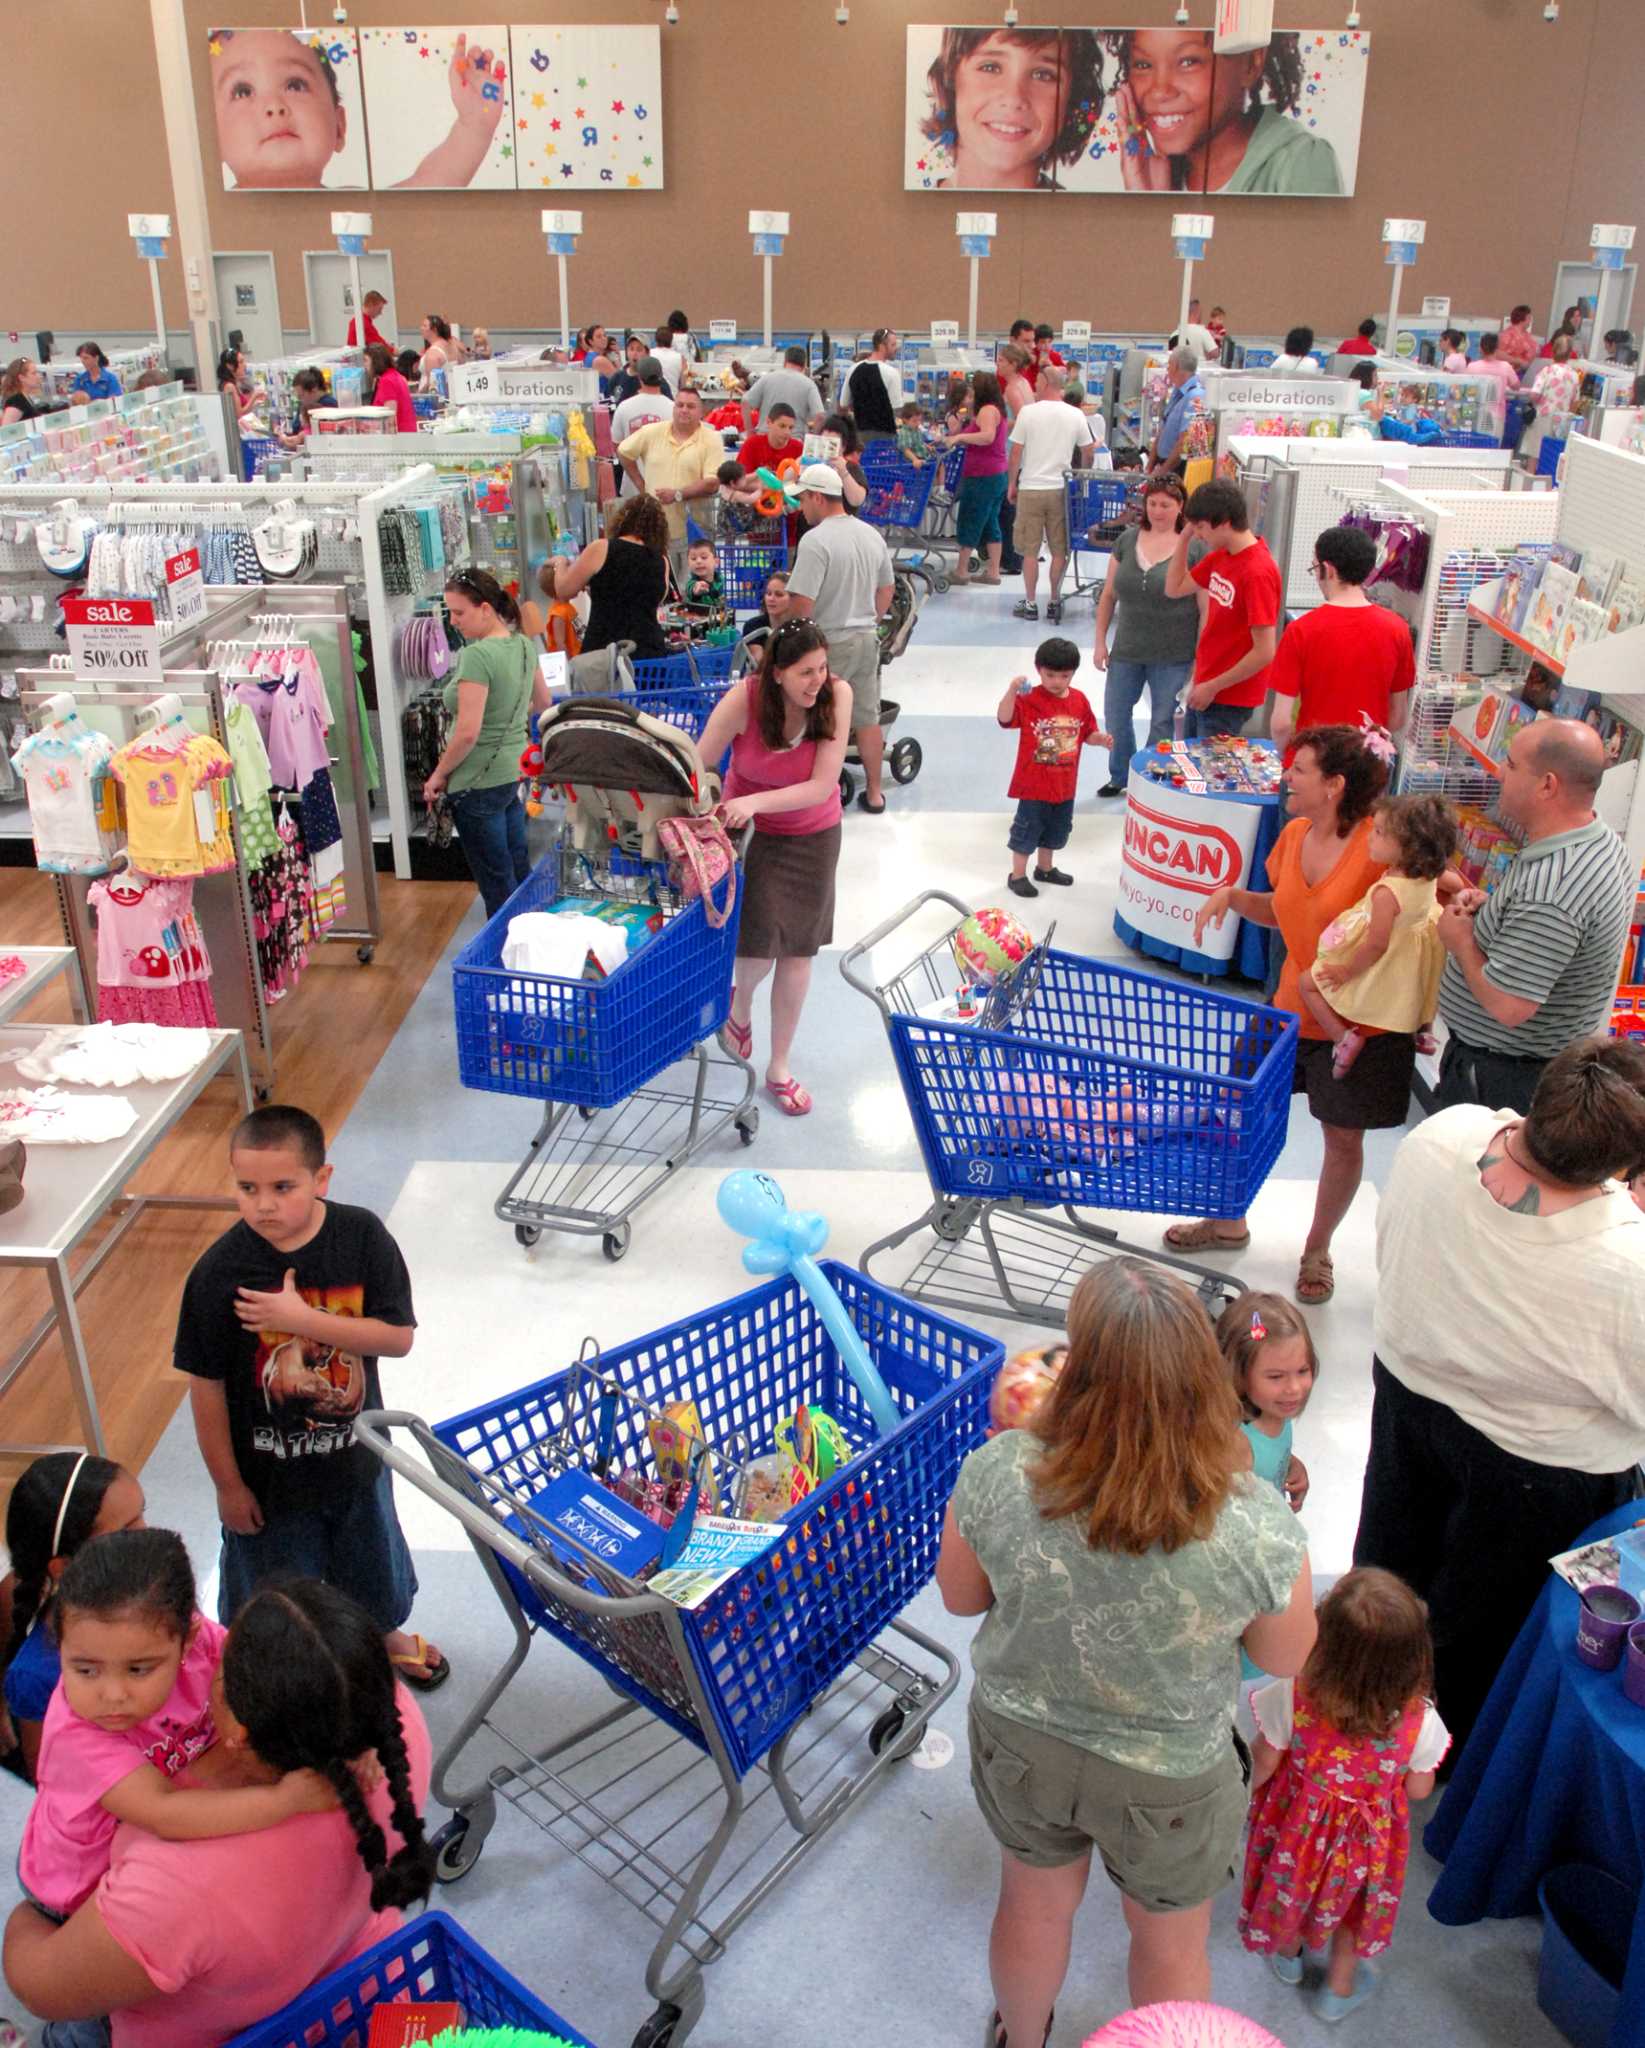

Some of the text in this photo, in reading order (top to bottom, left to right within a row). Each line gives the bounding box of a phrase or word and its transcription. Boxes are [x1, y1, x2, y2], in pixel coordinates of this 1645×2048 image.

[553, 213, 565, 229] 8
[1400, 222, 1420, 240] 12
[1612, 227, 1631, 245] 13
[466, 377, 488, 393] 1.49
[499, 380, 574, 396] brations
[1228, 387, 1336, 406] celebrations
[173, 554, 193, 577] sale
[86, 602, 134, 622] sale
[83, 649, 149, 668] 50% Off
[1124, 813, 1223, 879] UNCAN
[691, 1531, 734, 1547] BRAND
